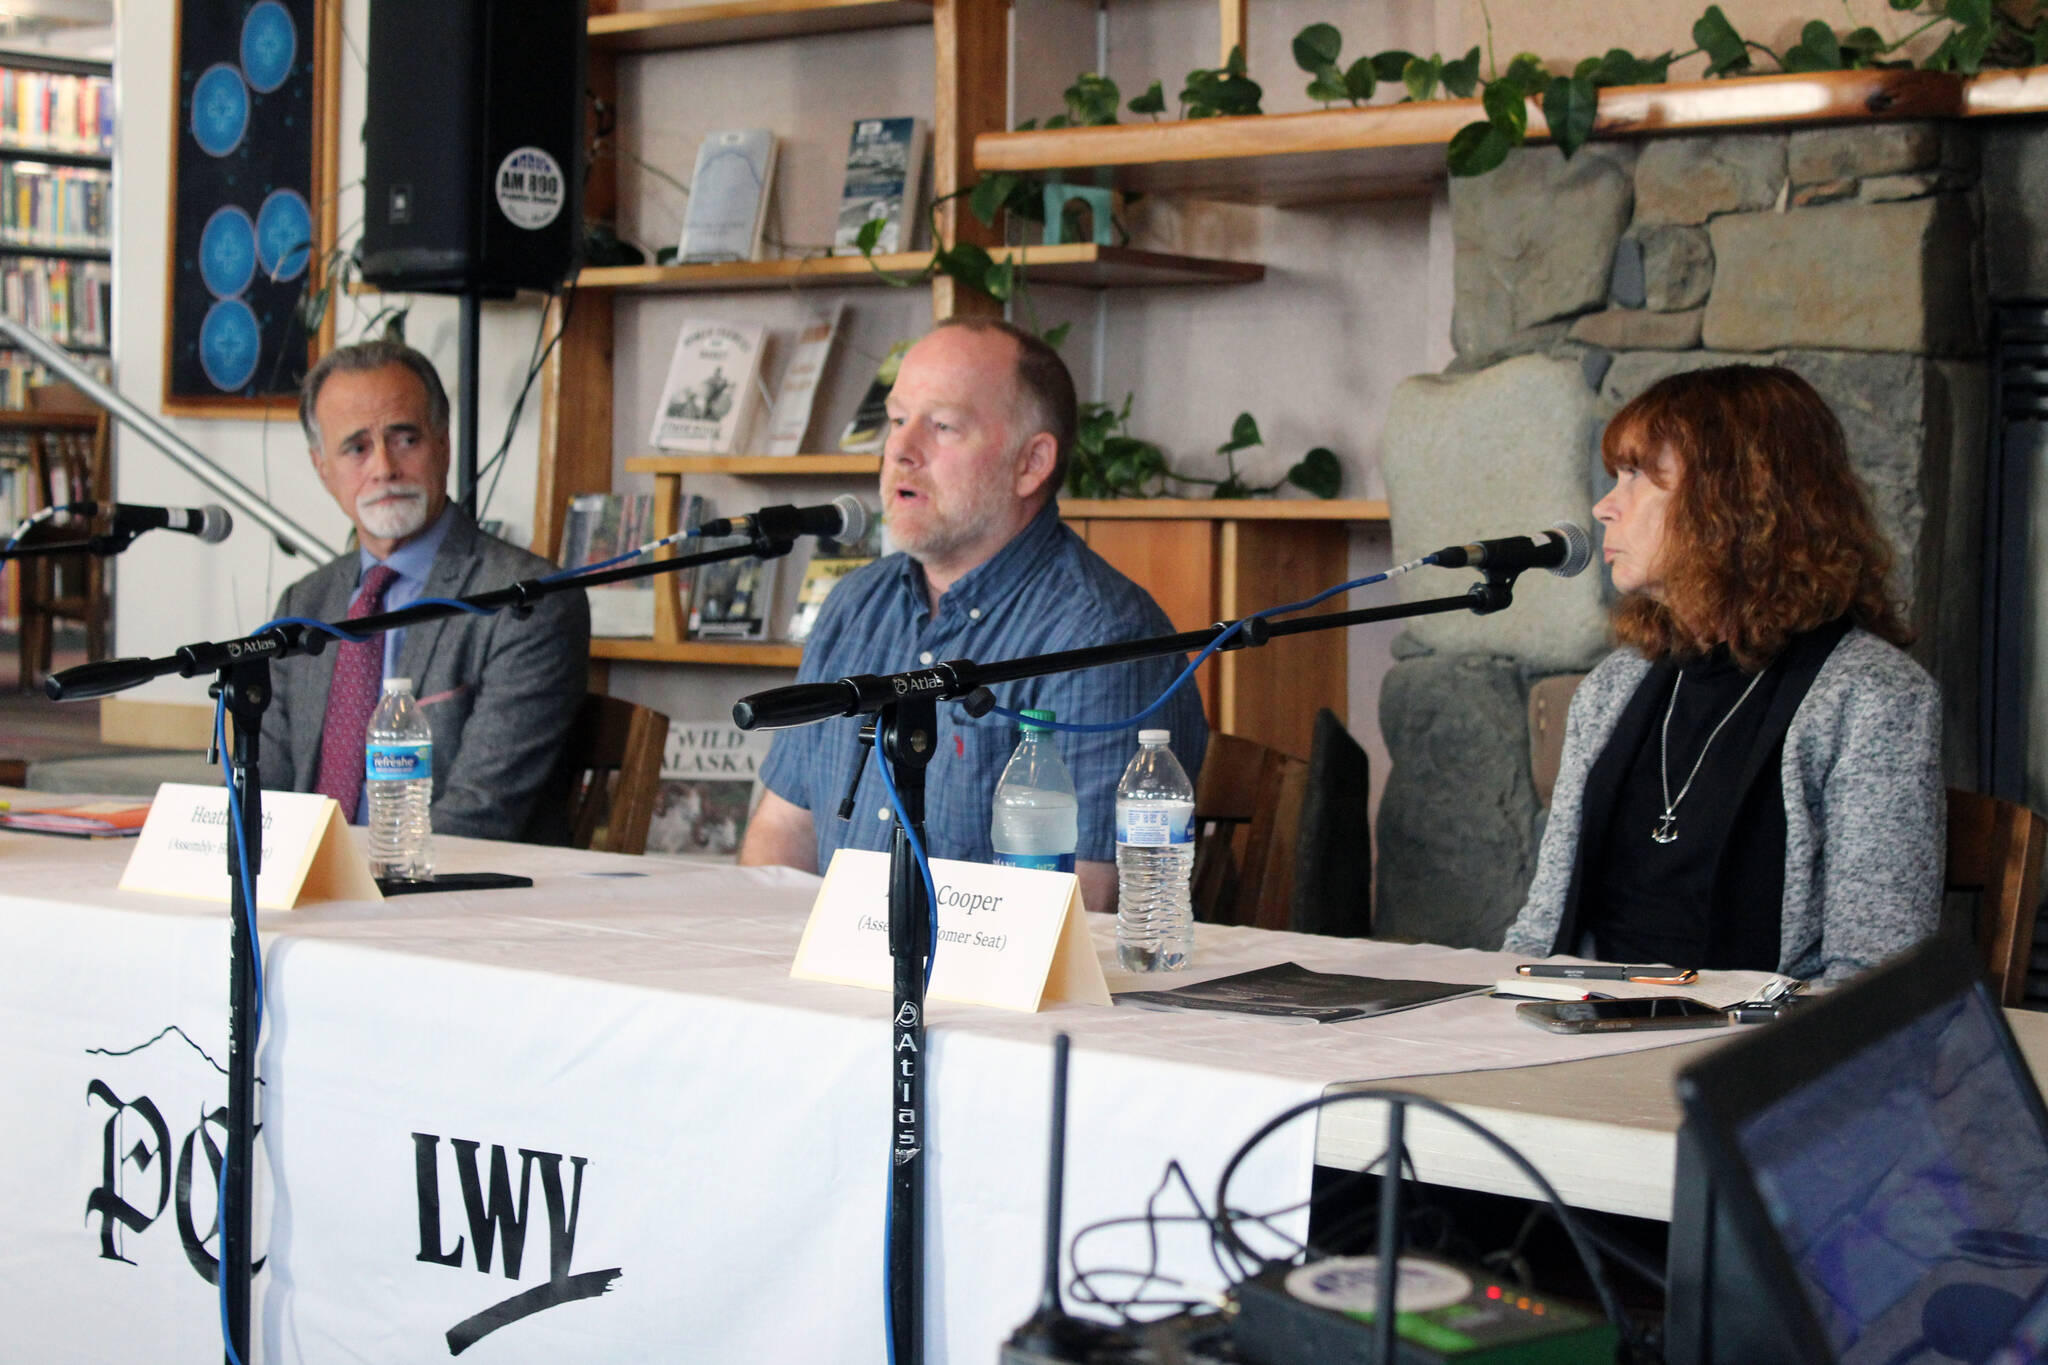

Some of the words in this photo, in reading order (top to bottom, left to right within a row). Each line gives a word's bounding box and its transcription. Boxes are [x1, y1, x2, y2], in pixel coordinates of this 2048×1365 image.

[501, 172, 524, 191] AM
[528, 174, 558, 194] 890
[243, 640, 277, 654] Atlas
[910, 676, 945, 690] Atlas
[669, 727, 744, 749] WILD
[937, 884, 1003, 916] Cooper
[937, 925, 972, 945] omer
[973, 931, 1008, 952] Seat)
[897, 1033, 918, 1145] Atlas
